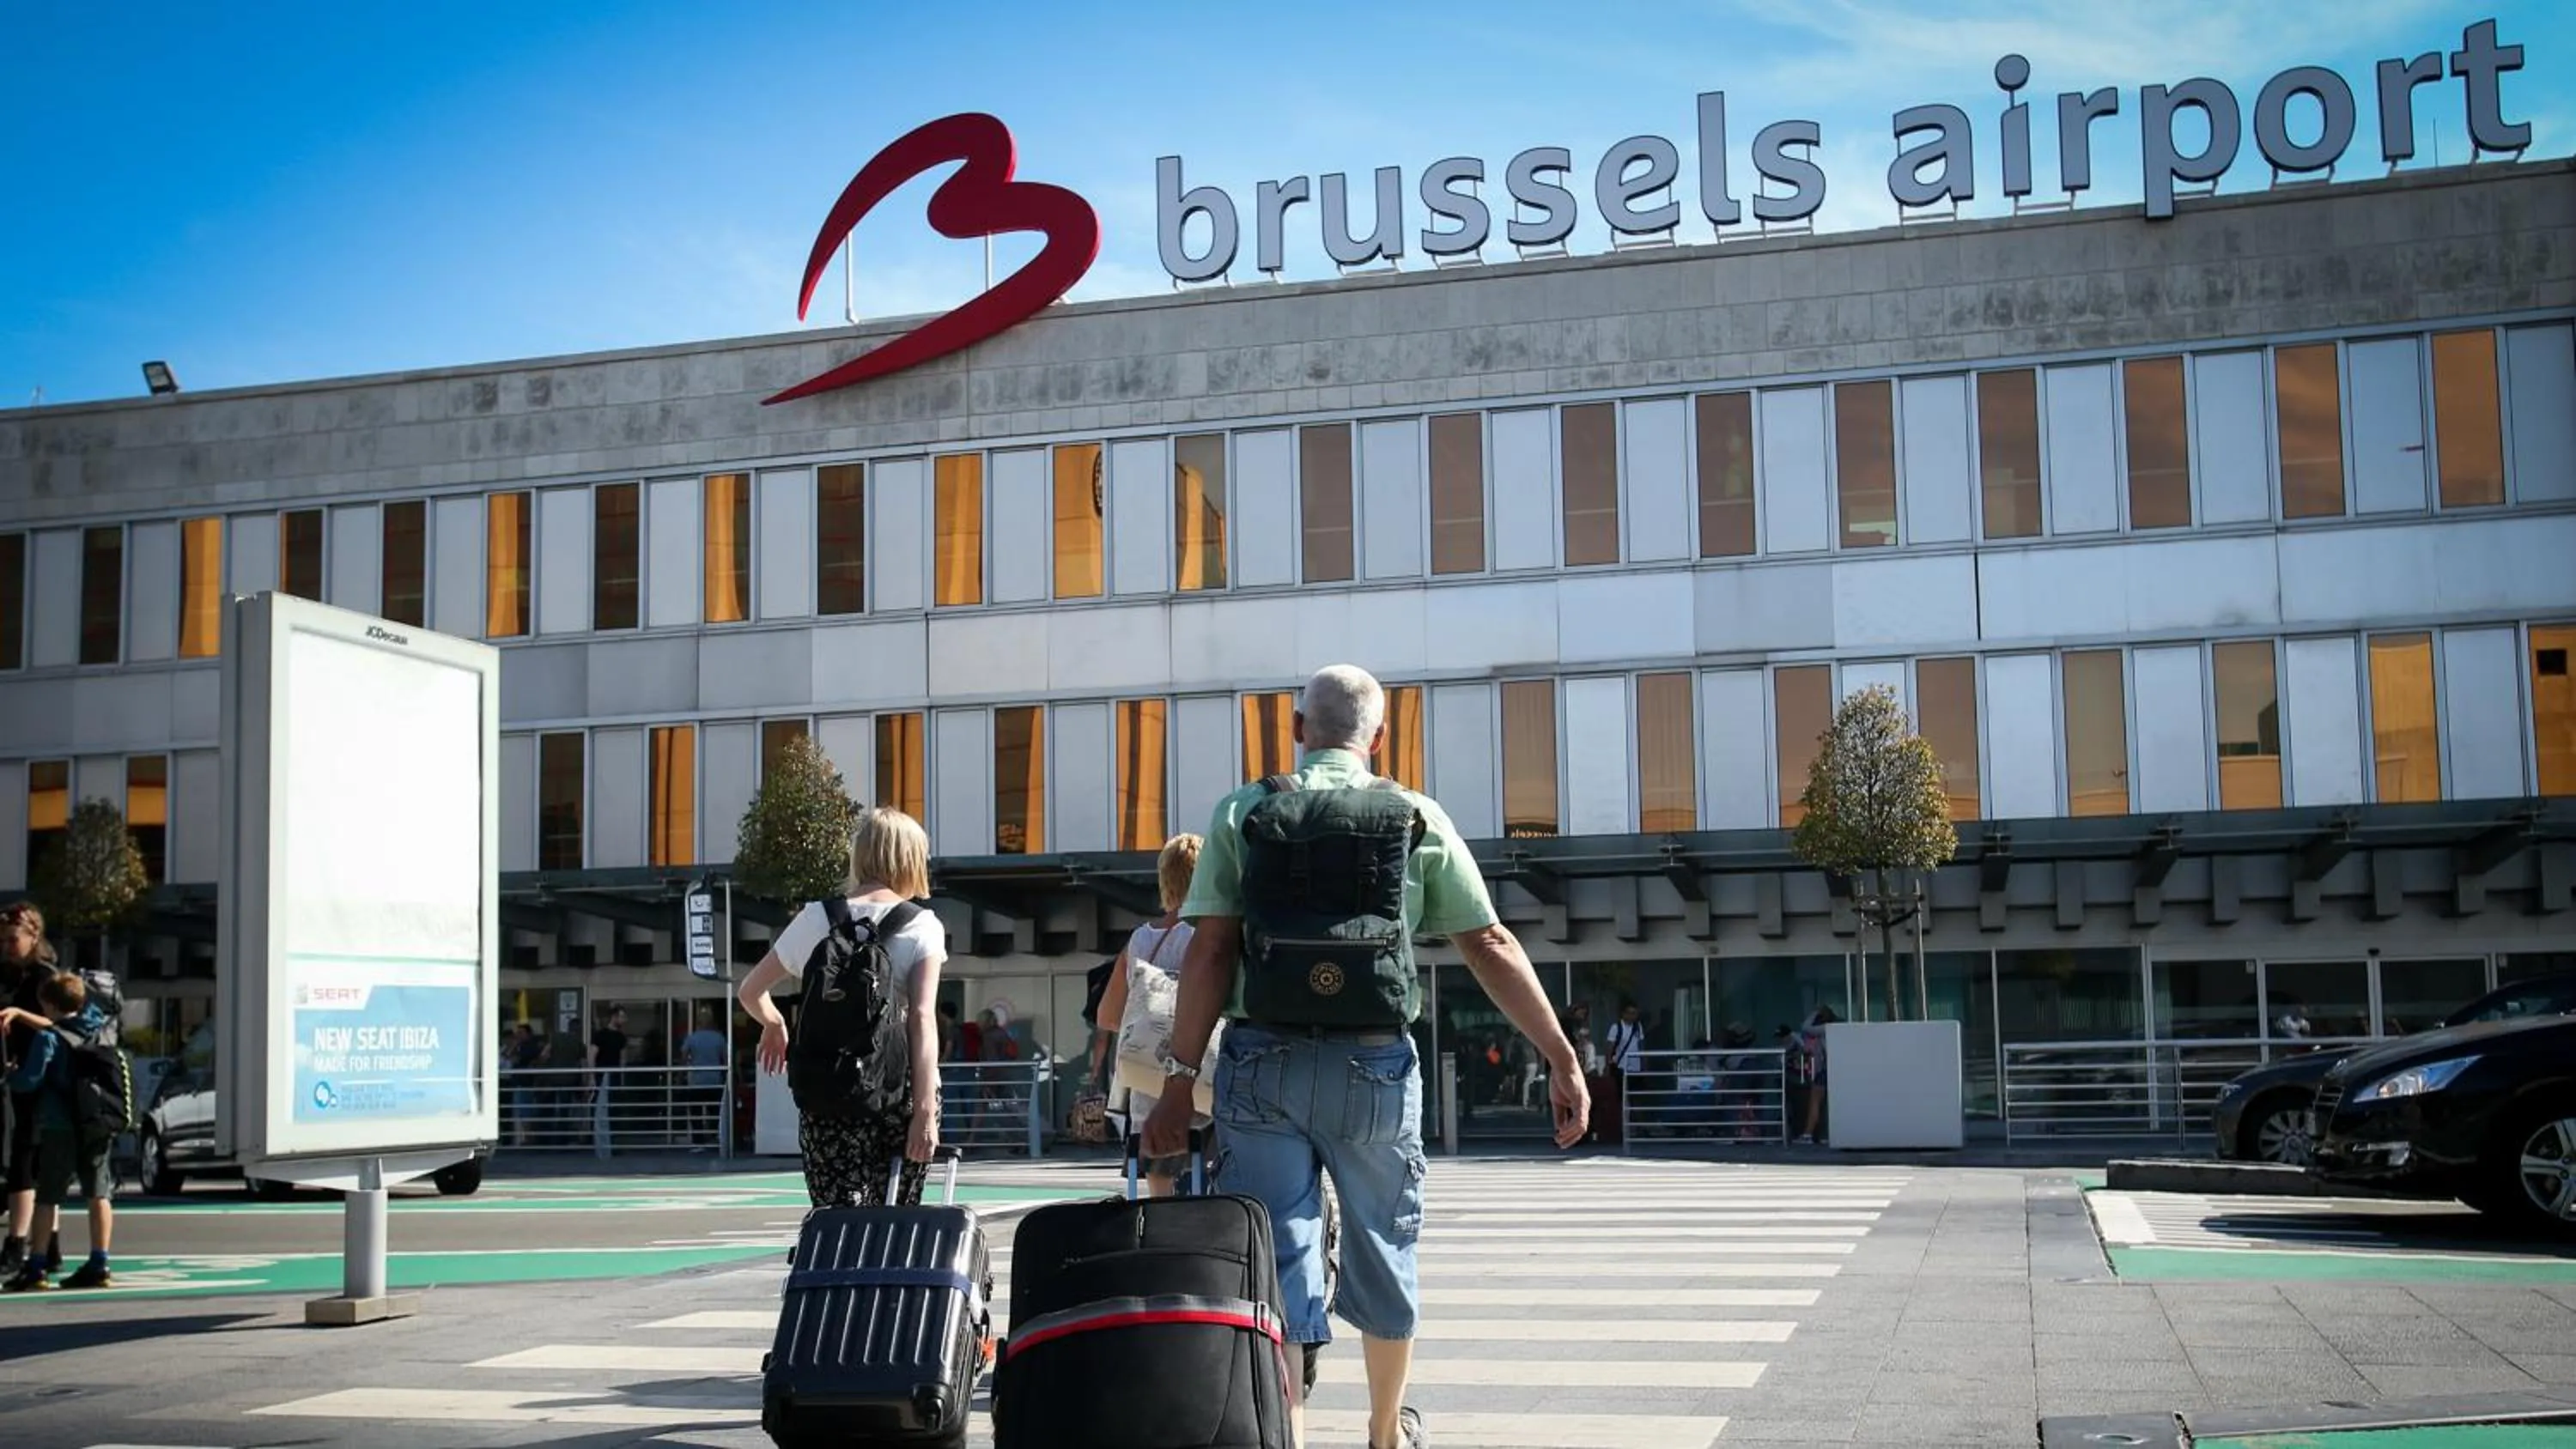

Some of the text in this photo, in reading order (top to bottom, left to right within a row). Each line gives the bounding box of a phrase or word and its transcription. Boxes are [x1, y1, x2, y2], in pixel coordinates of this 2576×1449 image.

[1156, 19, 2532, 282] brussels airport
[366, 625, 408, 645] JCDecaux
[313, 988, 361, 1000] SEAT
[314, 1027, 440, 1050] NEW SEAT IBIZA
[313, 1054, 432, 1072] MADE FOR FRIENDSHIP
